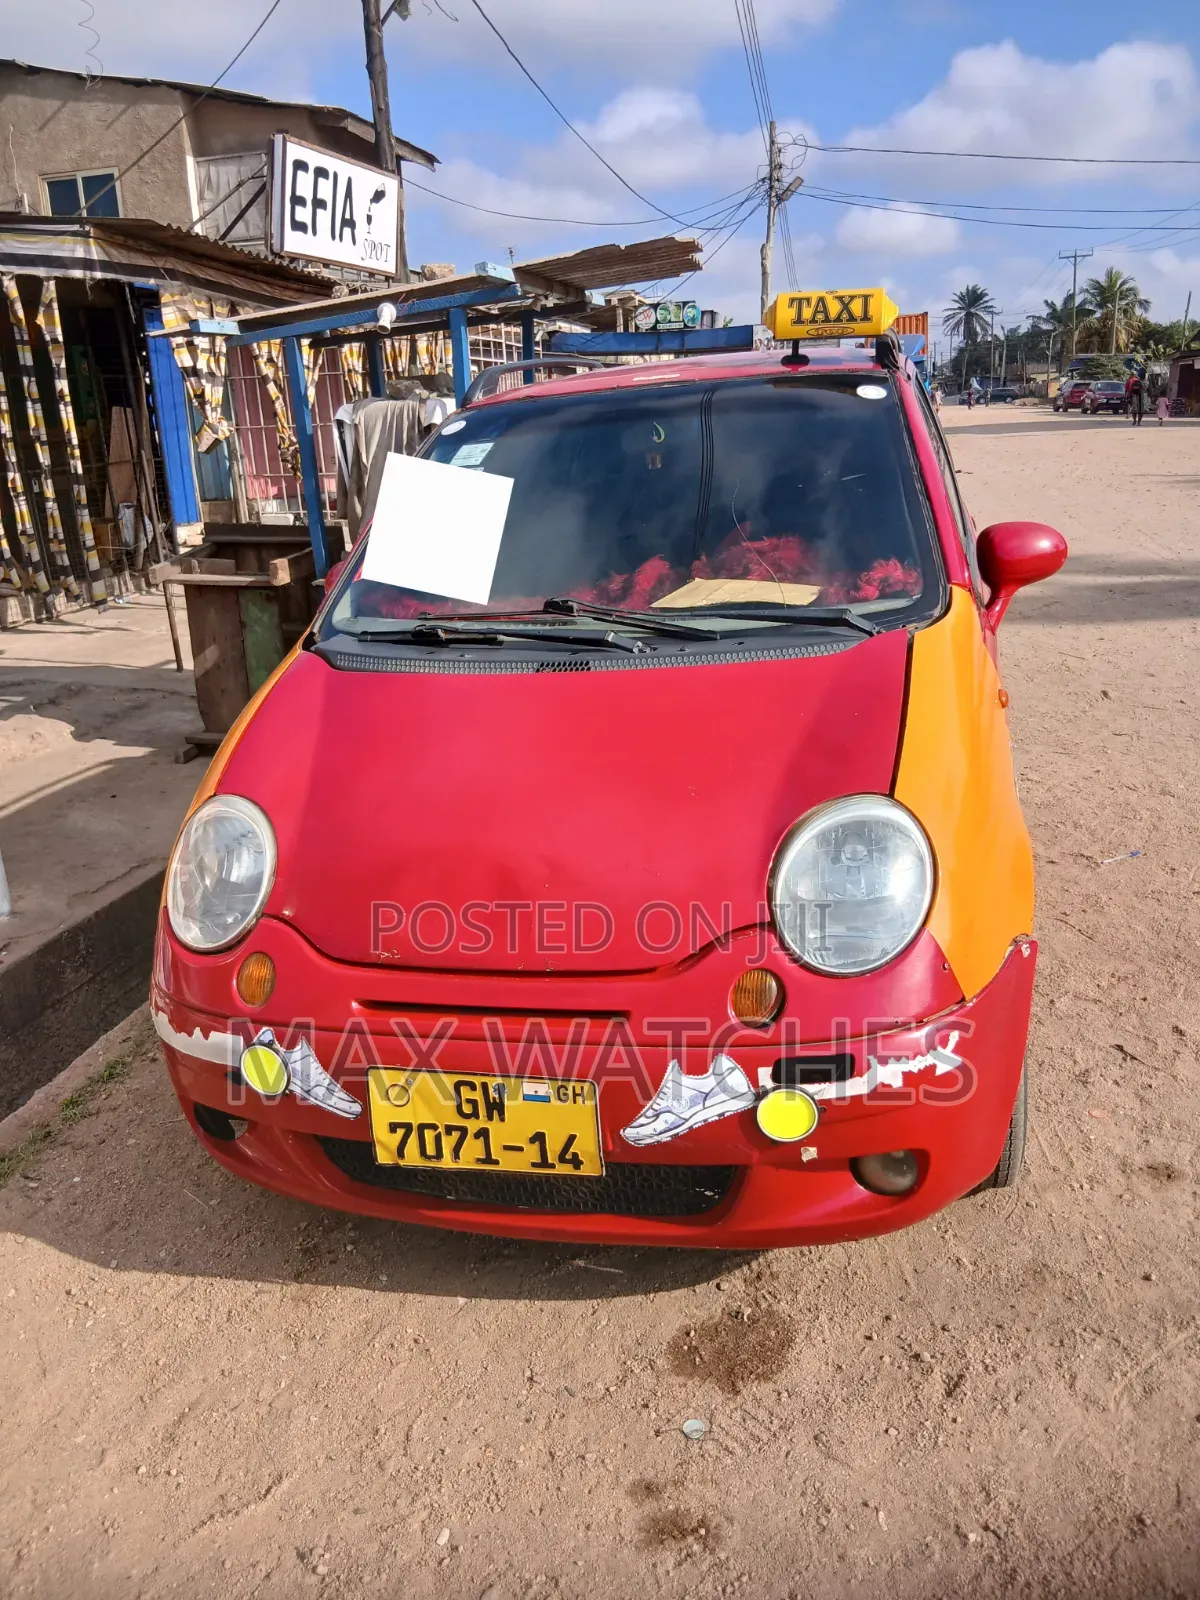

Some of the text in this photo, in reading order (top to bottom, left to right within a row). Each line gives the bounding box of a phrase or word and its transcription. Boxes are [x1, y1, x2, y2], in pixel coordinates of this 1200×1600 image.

[290, 158, 357, 246] EFIA
[361, 238, 391, 263] SPOT
[788, 294, 874, 326] TAXI
[454, 1080, 506, 1122] GW
[557, 1085, 586, 1105] GH
[389, 1121, 585, 1171] 7071-14
